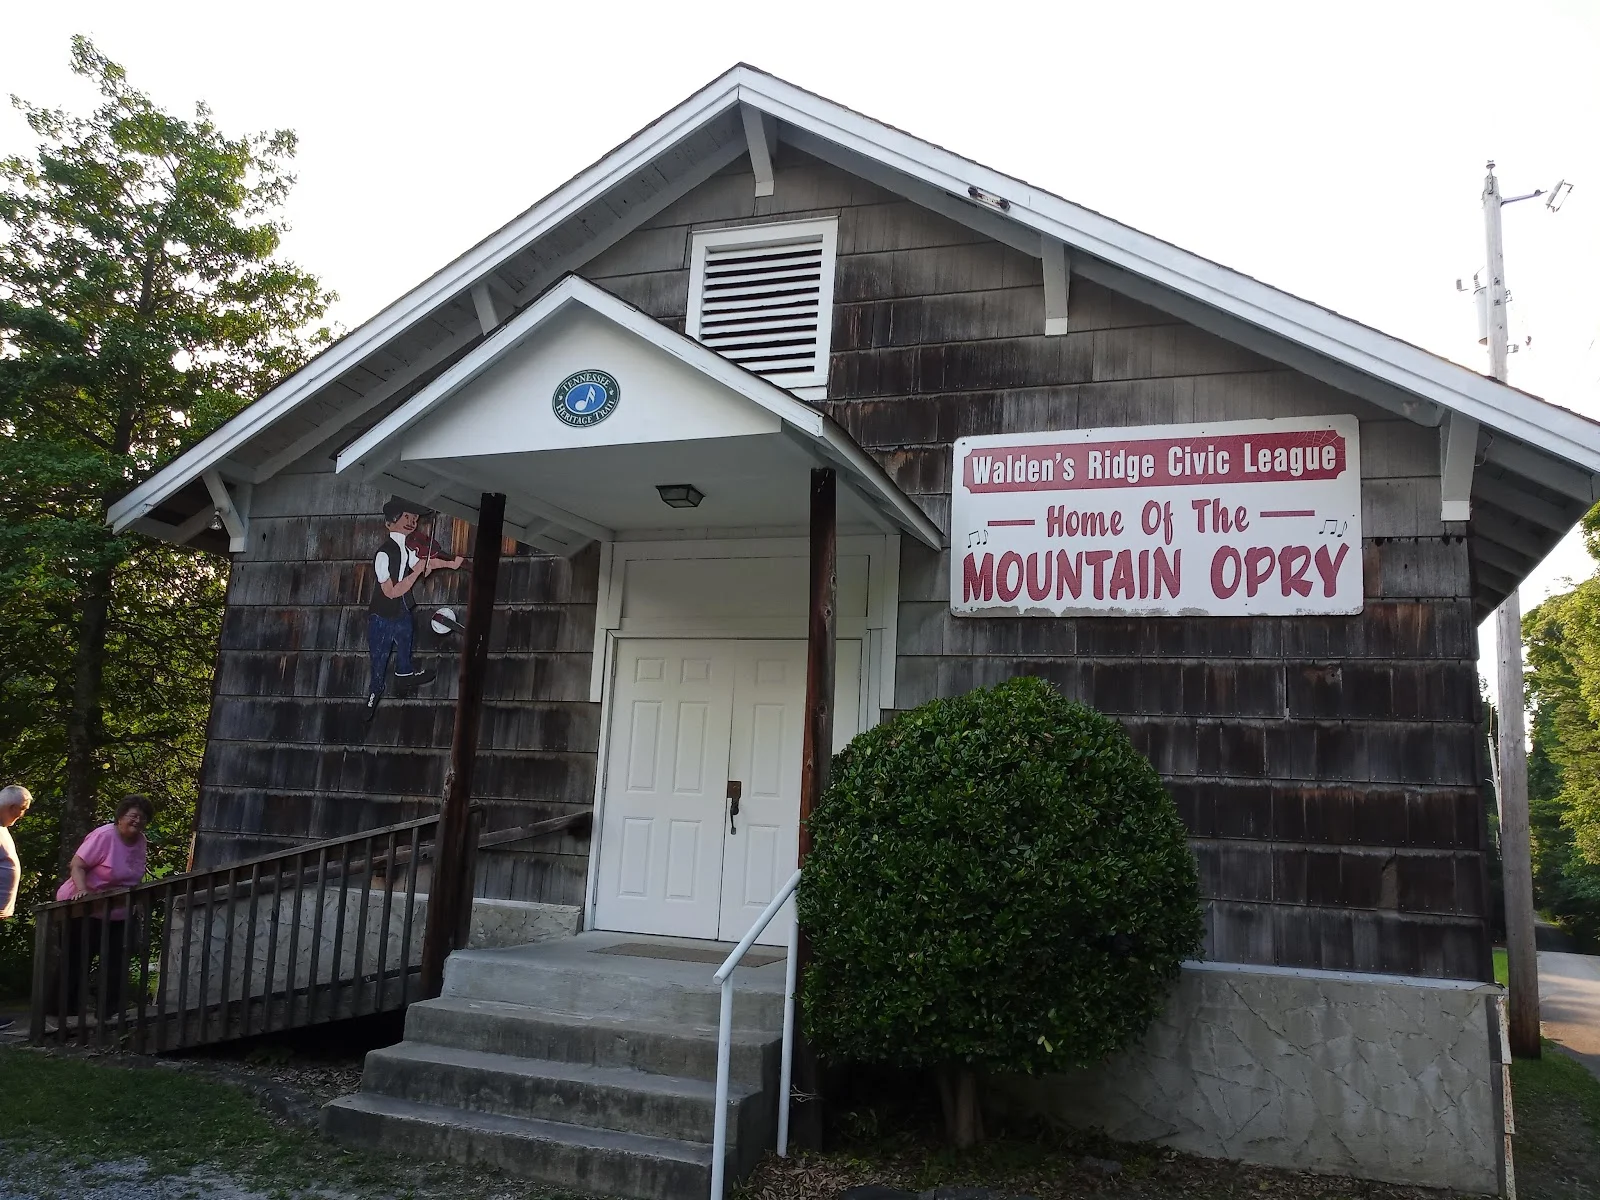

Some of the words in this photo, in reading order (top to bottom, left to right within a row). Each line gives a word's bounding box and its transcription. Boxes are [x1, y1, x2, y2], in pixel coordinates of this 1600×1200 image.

[561, 373, 611, 391] TENNESSEE
[556, 403, 593, 425] HERITAGE
[592, 399, 616, 420] TRAIL
[972, 454, 1076, 485] Walden's
[1088, 448, 1156, 483] Ridge
[1168, 445, 1230, 476] Civic
[1245, 442, 1337, 474] League
[1046, 505, 1125, 538] Home
[1141, 499, 1174, 546] Of
[1191, 498, 1250, 534] The
[963, 547, 1182, 604] MOUNTAIN
[1210, 543, 1350, 600] OPRY
